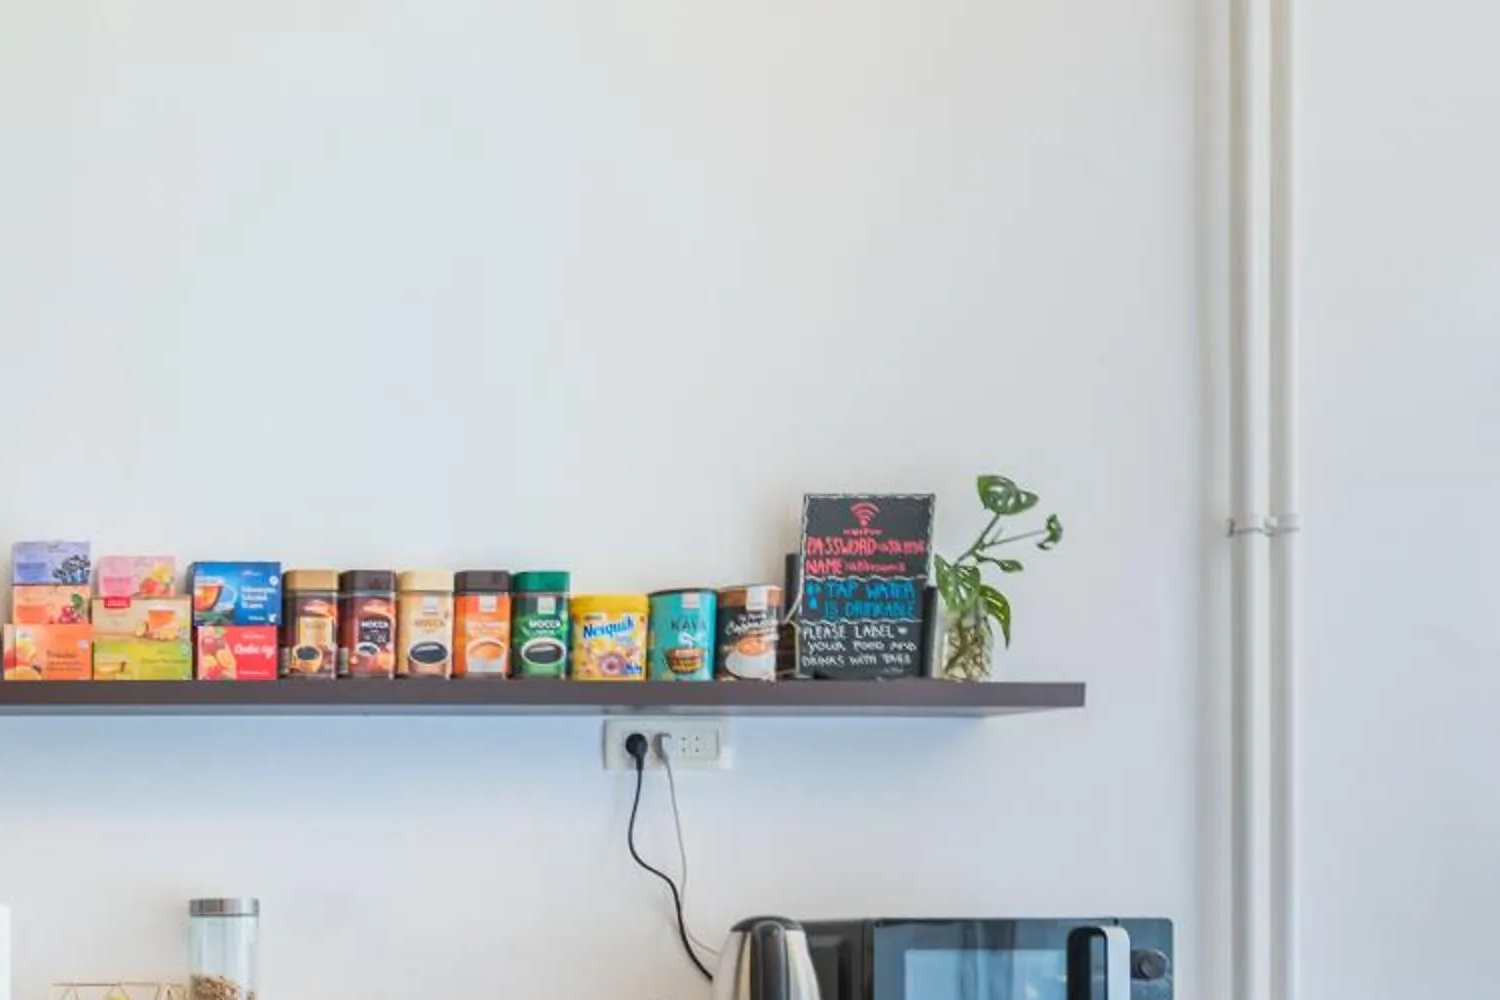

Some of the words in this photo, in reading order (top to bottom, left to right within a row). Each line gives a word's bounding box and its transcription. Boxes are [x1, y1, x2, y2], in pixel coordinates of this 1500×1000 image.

[583, 616, 635, 639] Nesquik
[803, 625, 845, 640] PLEASE
[855, 625, 895, 639] LABEL
[808, 641, 846, 654] YOUR
